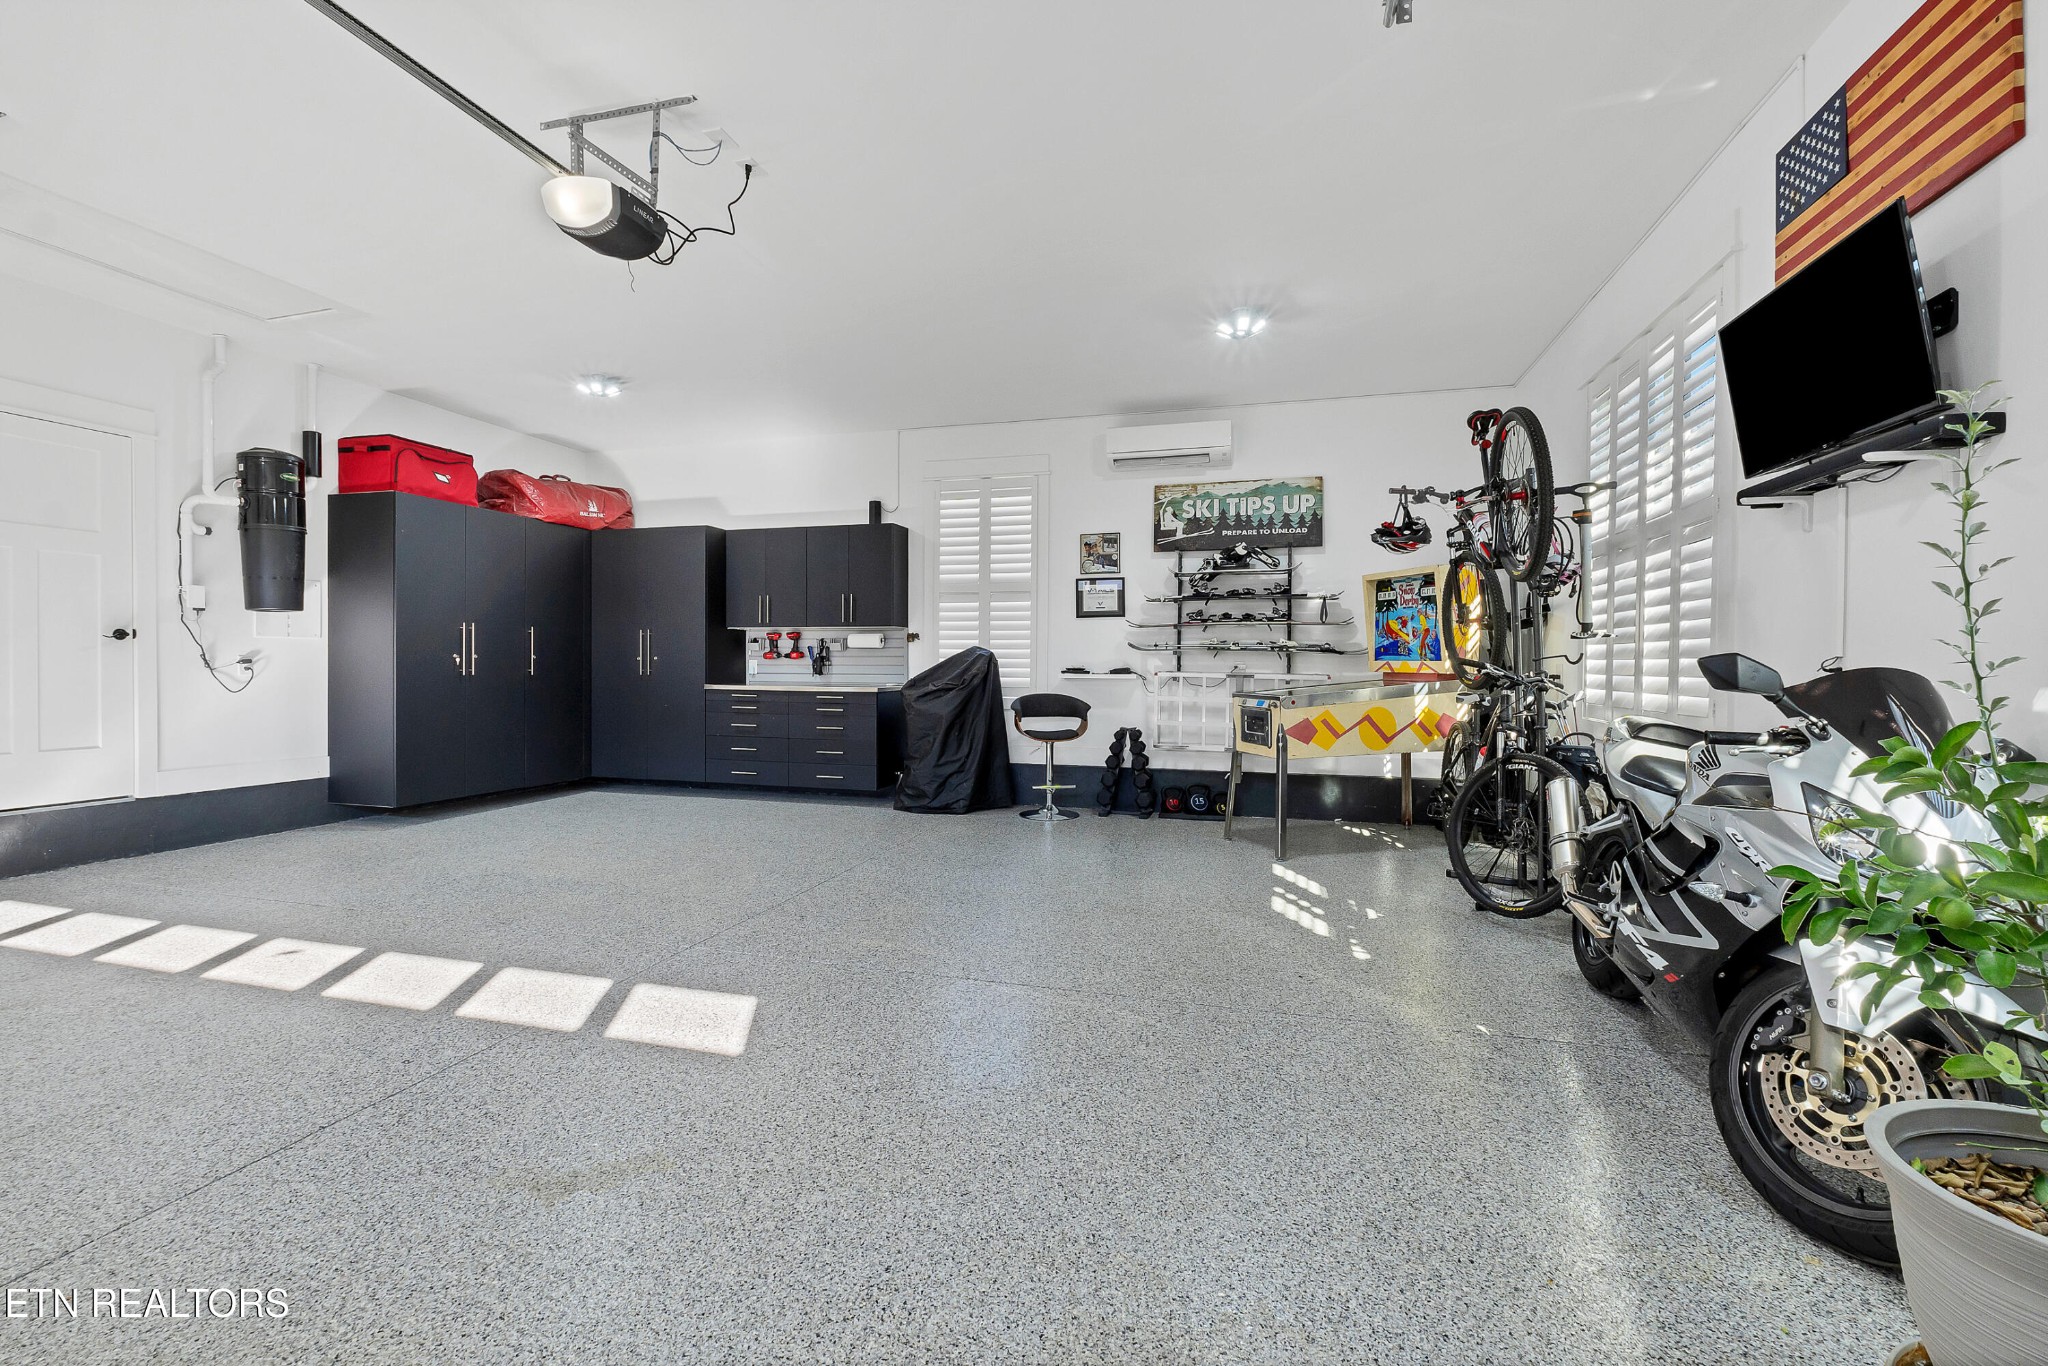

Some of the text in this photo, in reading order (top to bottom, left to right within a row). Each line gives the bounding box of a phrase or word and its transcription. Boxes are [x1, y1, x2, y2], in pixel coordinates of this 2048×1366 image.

[633, 204, 654, 225] LINEAR
[1182, 494, 1316, 519] SKI TIPS UP
[1272, 527, 1308, 535] UNLOAD
[1398, 584, 1416, 597] Snow
[1399, 595, 1420, 608] Derby
[1508, 763, 1538, 771] GIANT
[1689, 761, 1710, 781] ONDA
[1194, 797, 1205, 805] 15
[1617, 916, 1670, 971] F4
